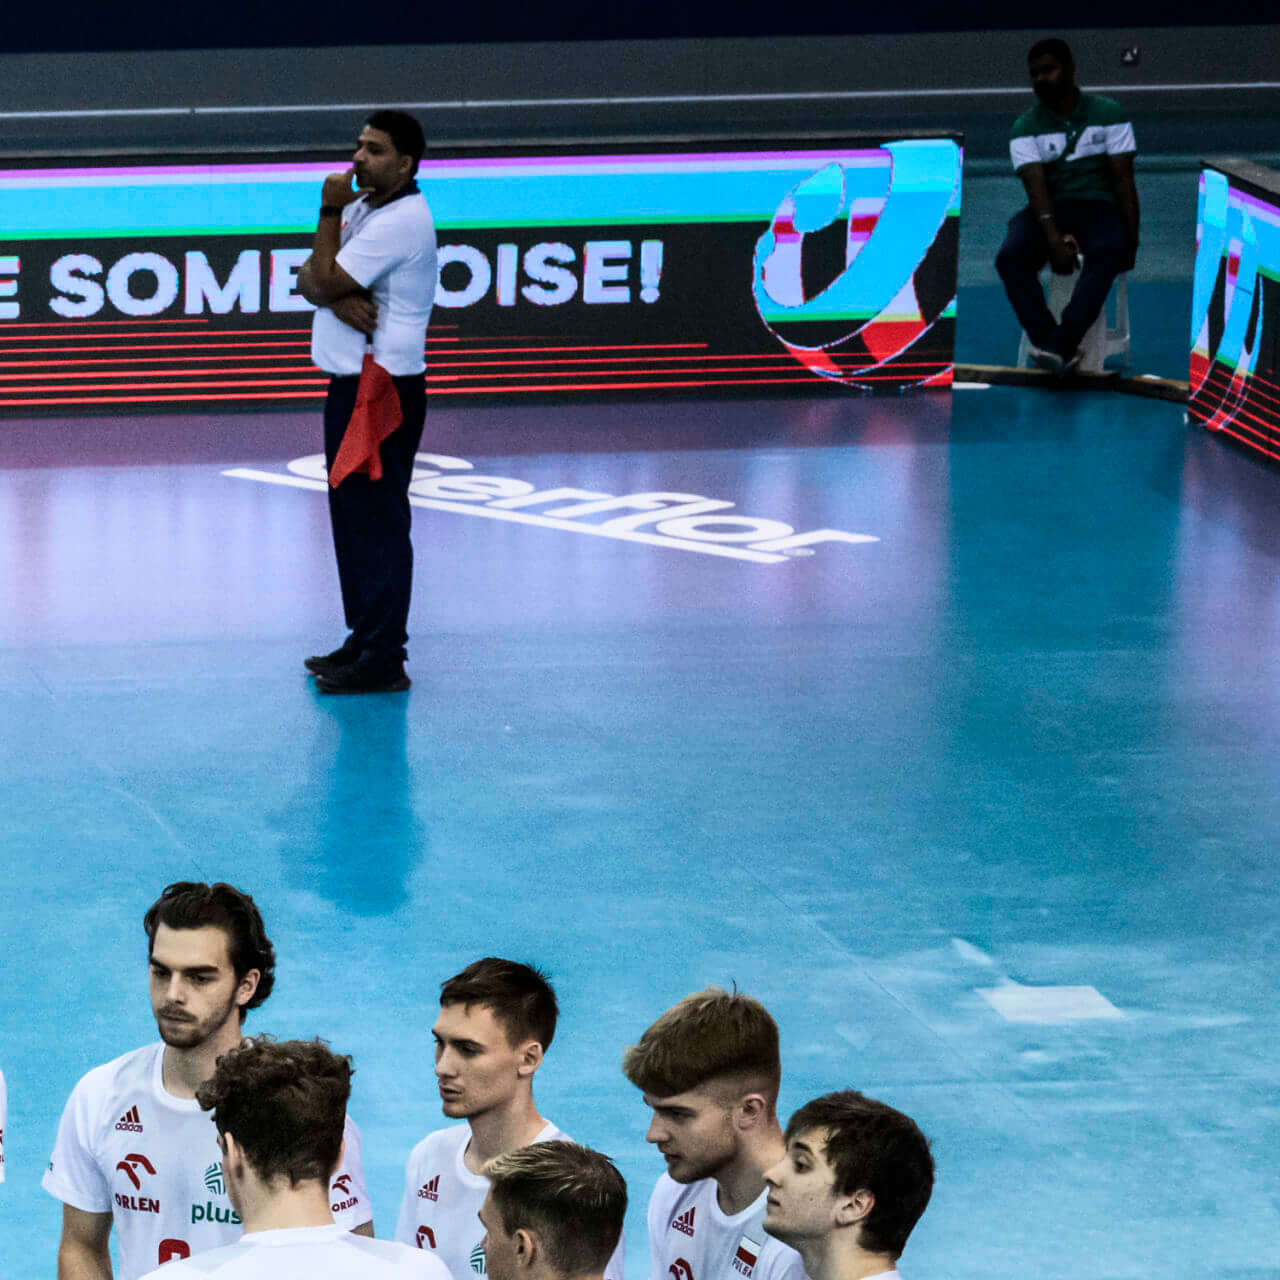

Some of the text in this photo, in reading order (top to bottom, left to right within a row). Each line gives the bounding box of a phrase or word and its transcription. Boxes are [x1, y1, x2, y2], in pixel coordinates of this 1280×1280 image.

[48, 248, 310, 318] SOME
[432, 240, 664, 310] OISE!
[114, 1192, 161, 1214] ORLEN
